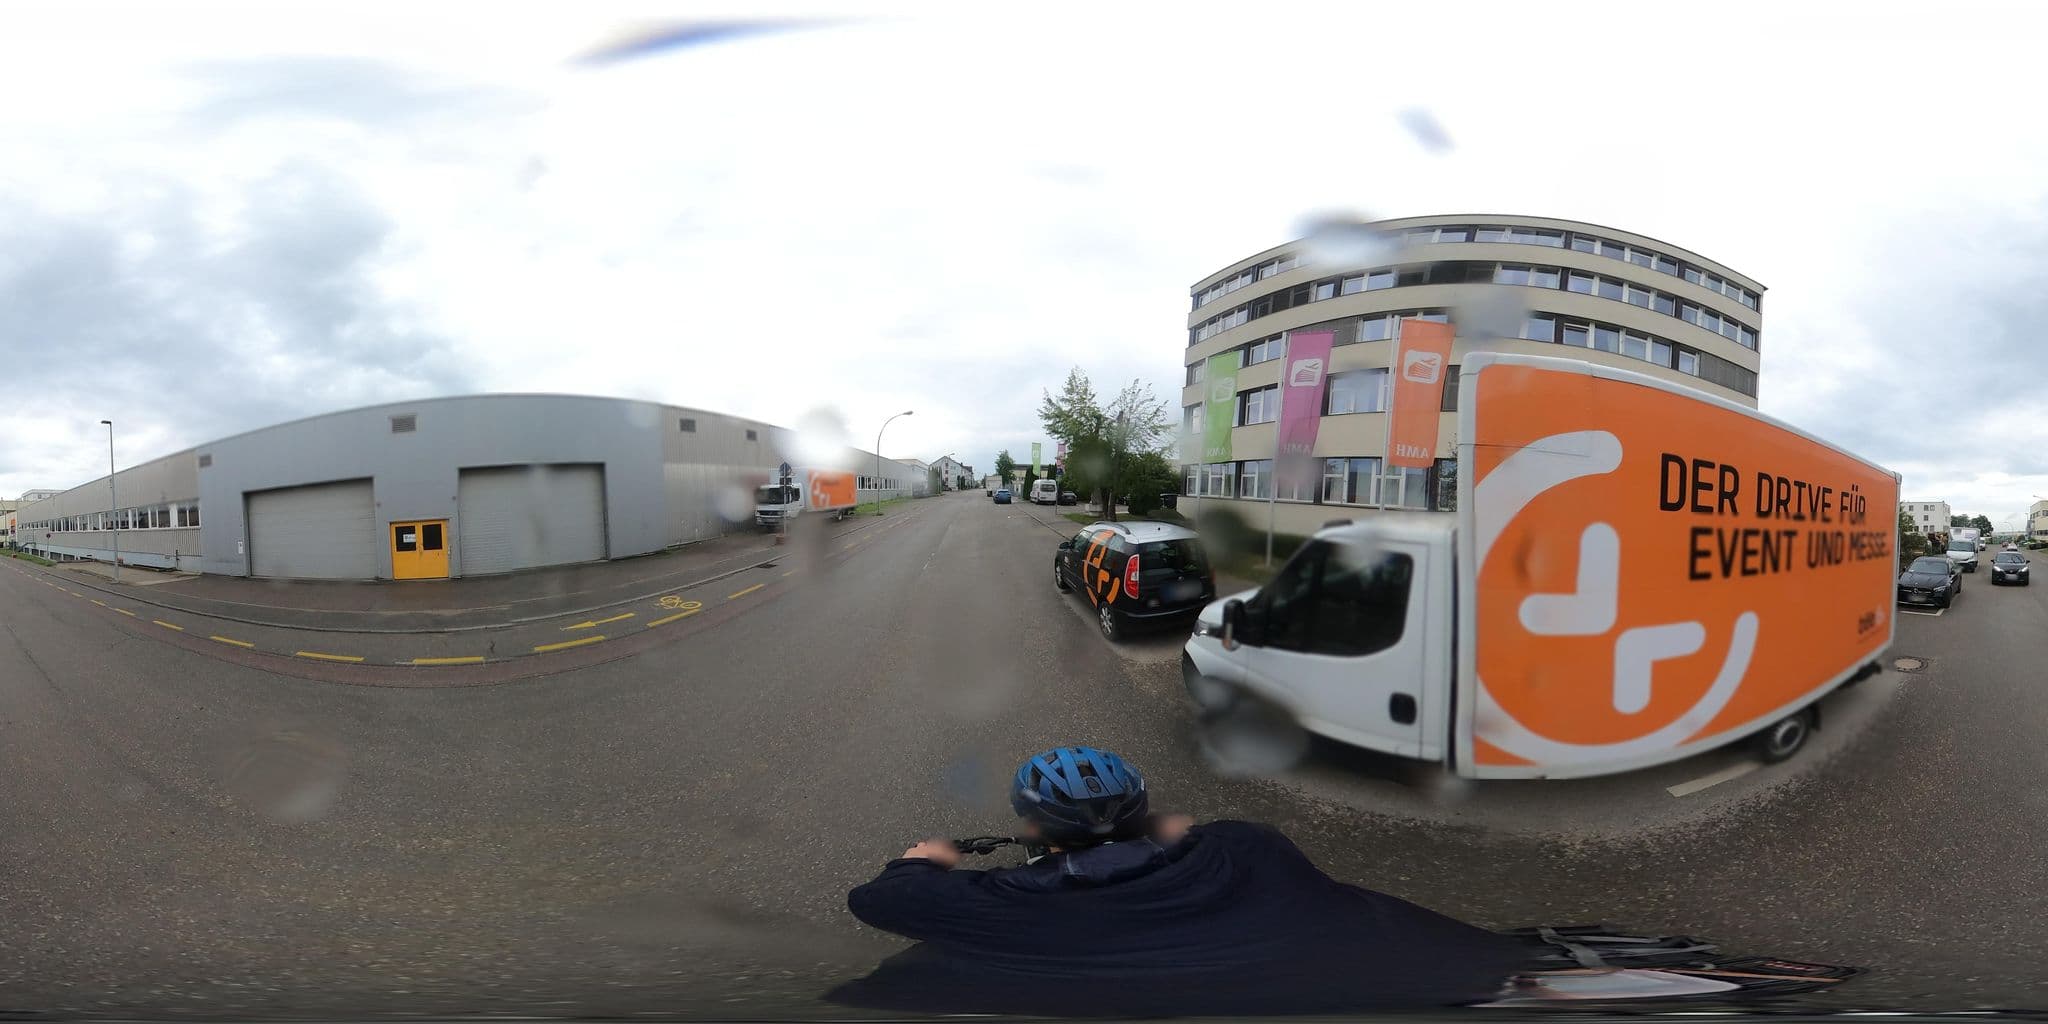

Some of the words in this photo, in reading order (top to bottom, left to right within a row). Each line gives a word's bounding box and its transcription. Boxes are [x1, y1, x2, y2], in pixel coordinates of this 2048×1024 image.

[1395, 443, 1429, 459] HMA
[1659, 453, 1740, 515] DER
[1756, 471, 1833, 522] DRIVE
[1840, 484, 1866, 525] FÜR
[1688, 526, 1798, 581] EVENT
[1807, 532, 1845, 568] UND
